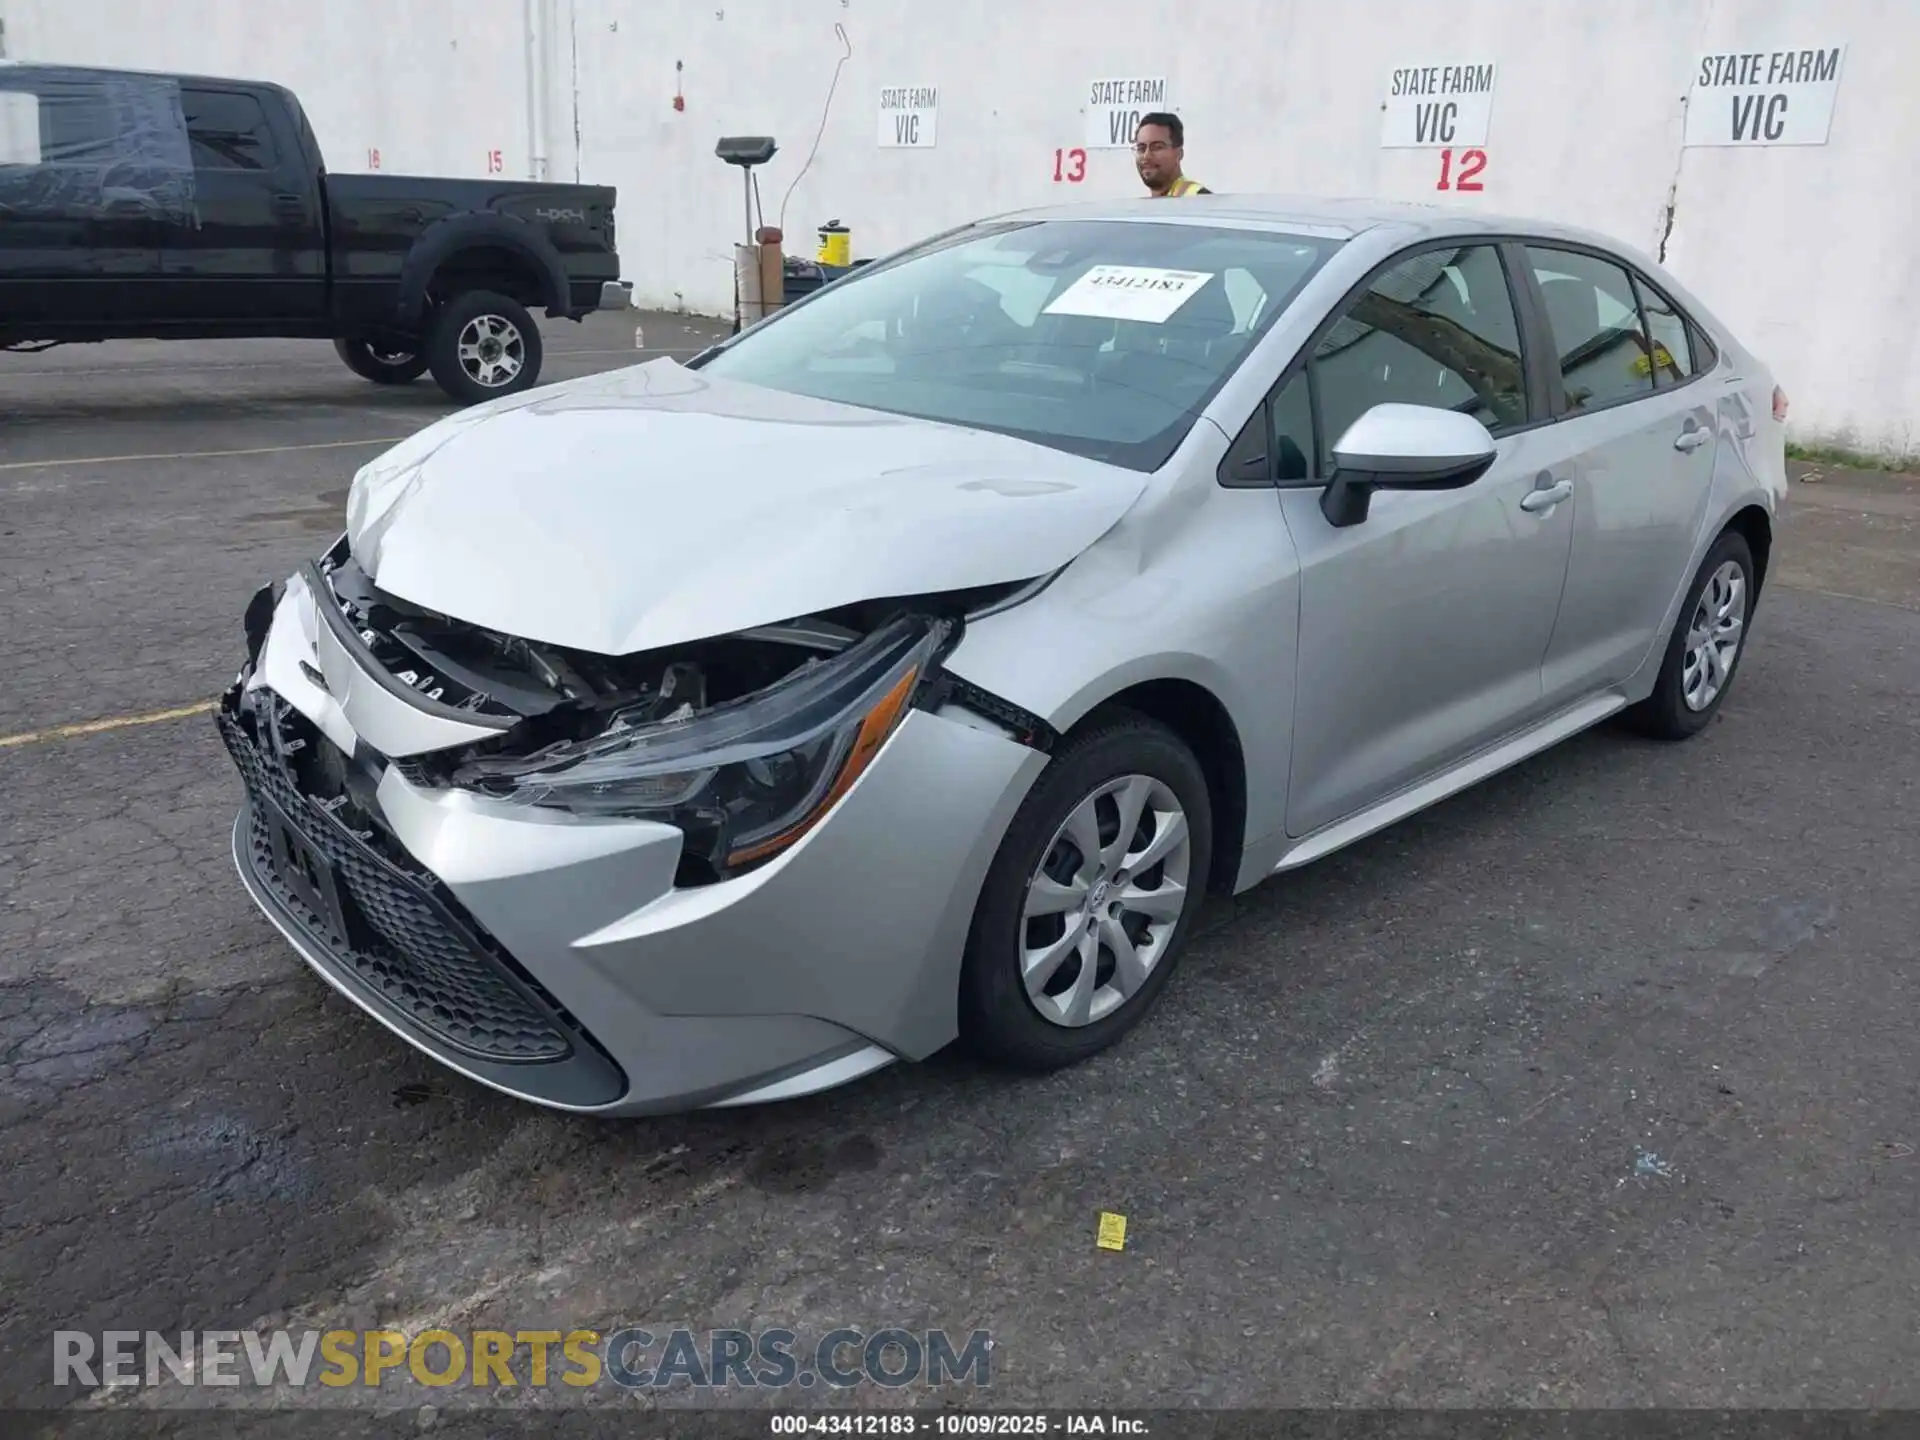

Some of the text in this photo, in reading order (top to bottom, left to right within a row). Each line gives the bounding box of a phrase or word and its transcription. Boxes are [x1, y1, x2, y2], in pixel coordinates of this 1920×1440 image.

[1392, 64, 1493, 96] STATE FARM
[1699, 48, 1840, 86] STATE FARM
[881, 87, 937, 109] STATE FARM
[1091, 79, 1164, 105] STATE FARM
[896, 114, 919, 144] VIC
[1109, 110, 1140, 144] VIC
[1415, 102, 1458, 143] VIC
[1730, 94, 1788, 141] VIC
[488, 150, 503, 173] 15
[1053, 148, 1087, 182] 13
[1437, 148, 1488, 191] 12
